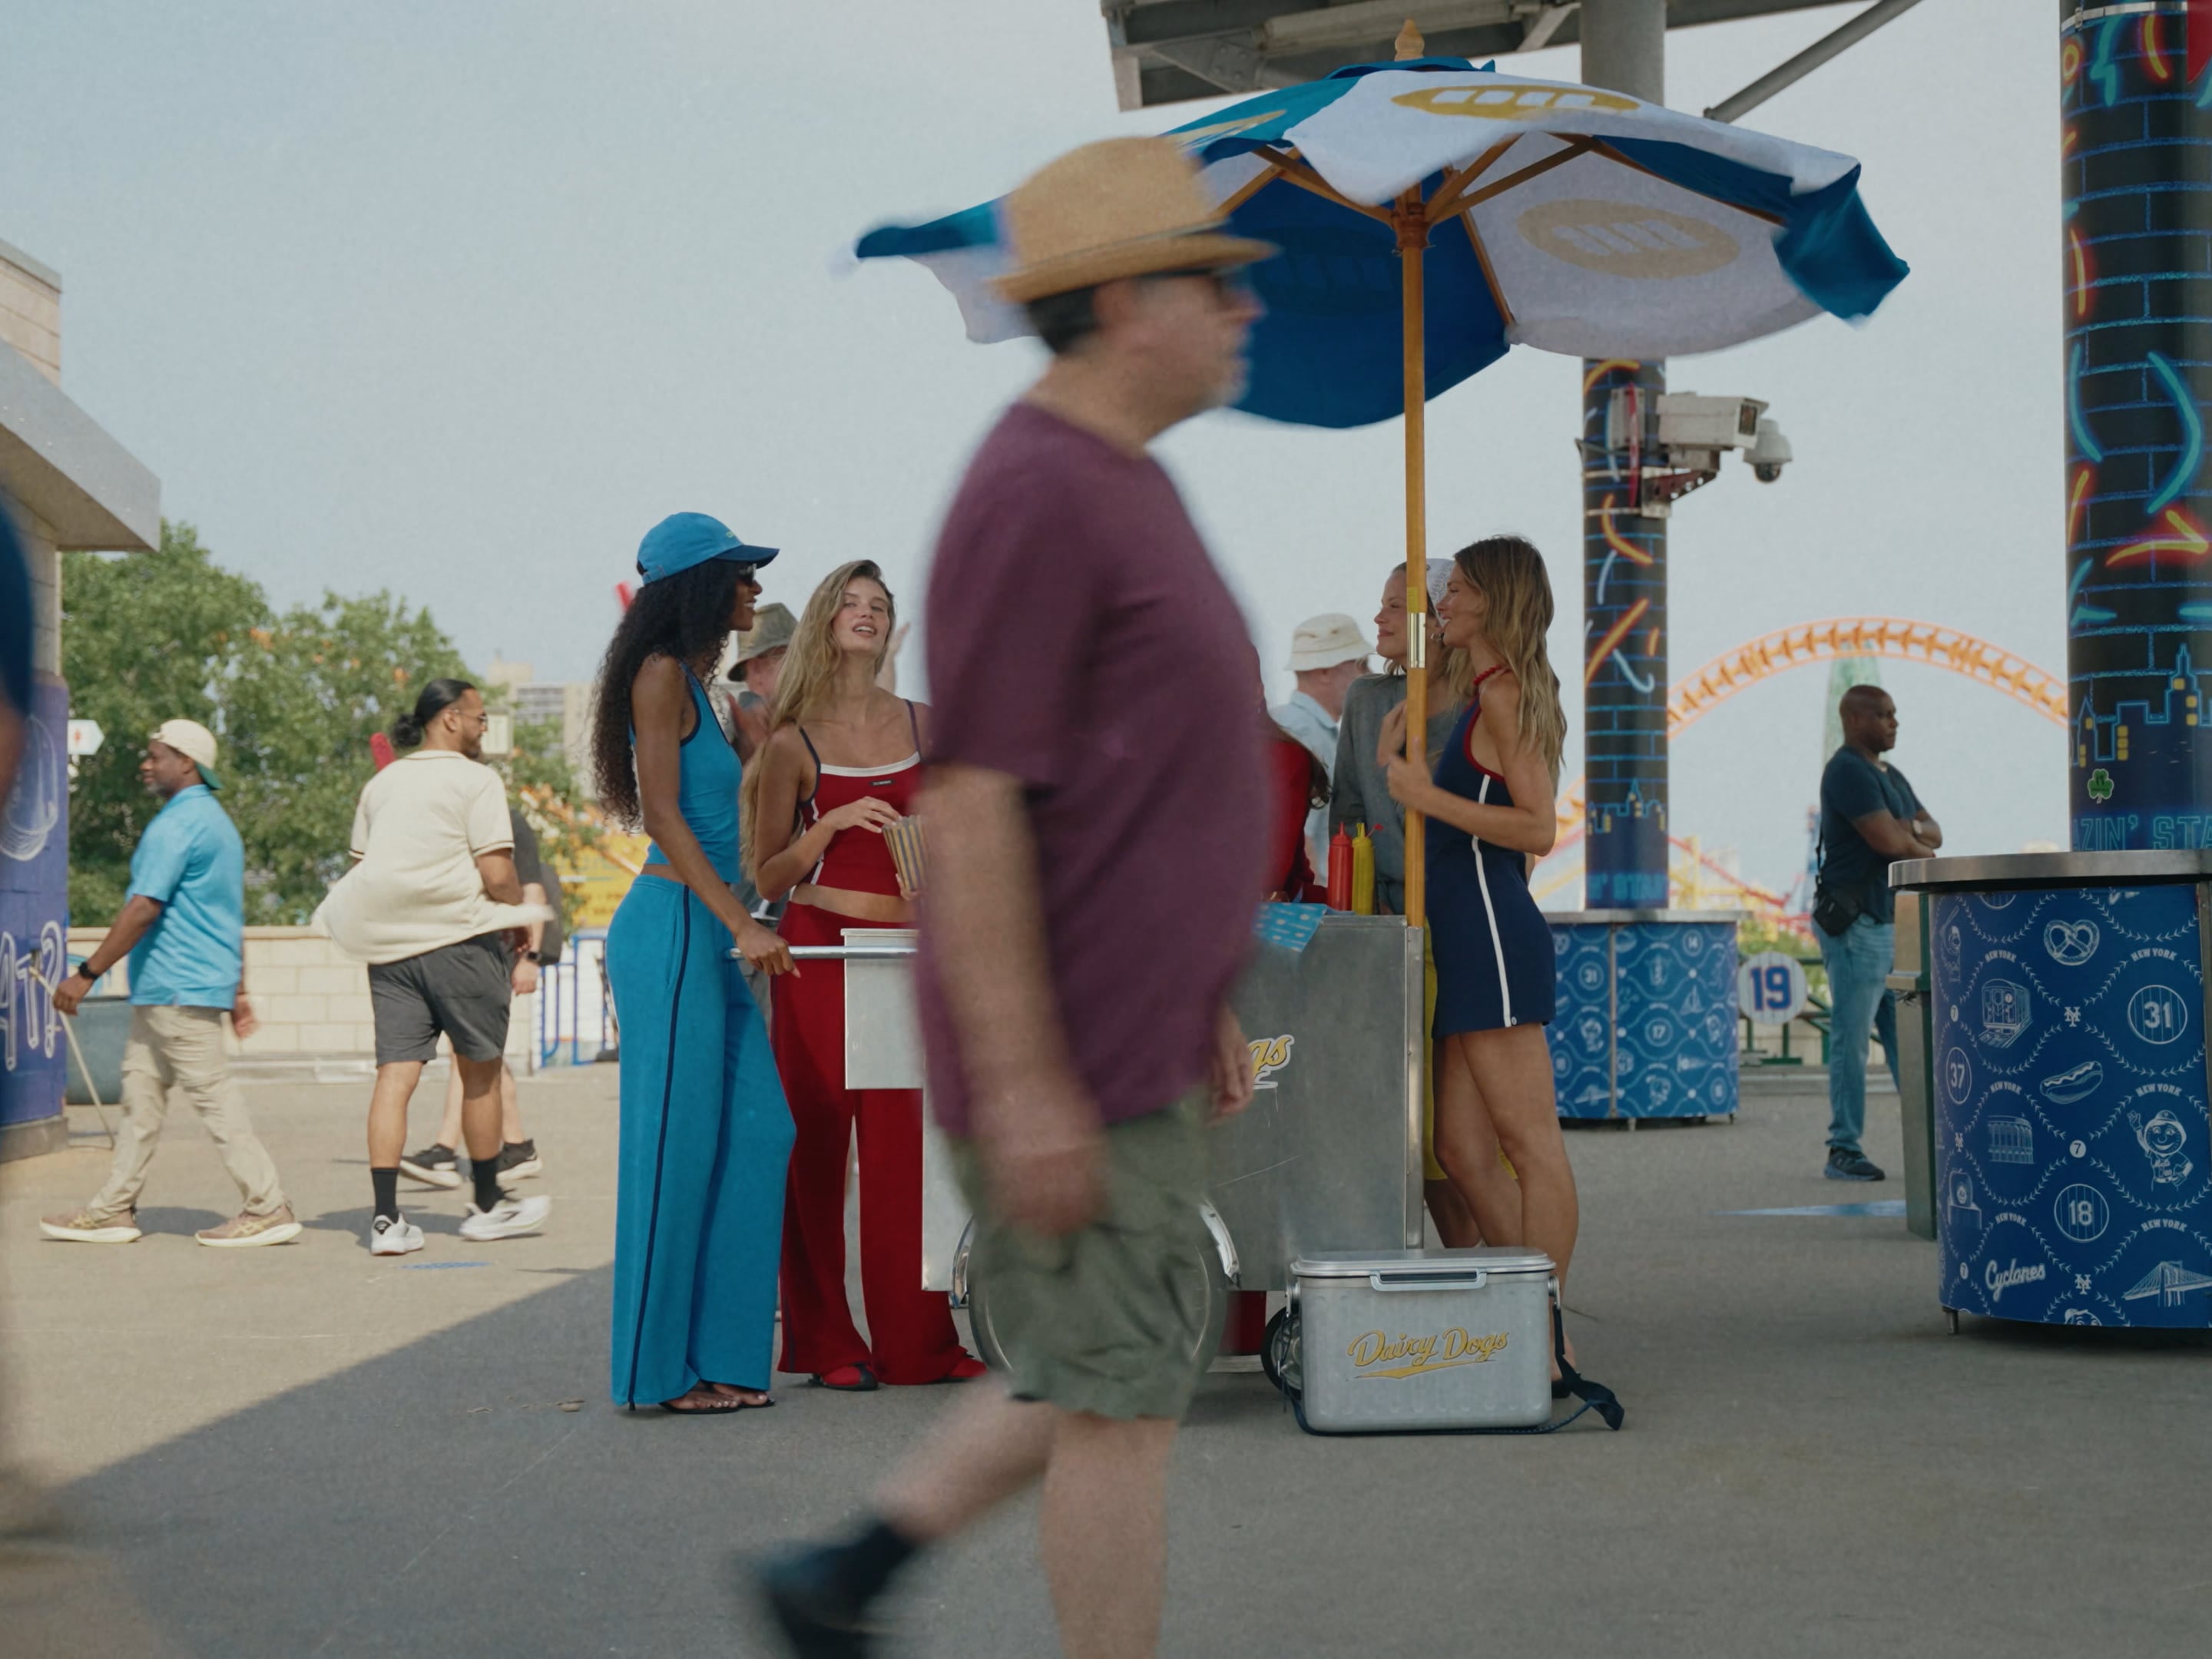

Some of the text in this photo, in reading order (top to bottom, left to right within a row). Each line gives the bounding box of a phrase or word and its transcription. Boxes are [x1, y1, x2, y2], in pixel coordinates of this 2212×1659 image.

[2131, 948, 2177, 962] NEW YORK
[1748, 965, 1793, 1012] 19
[2144, 1001, 2171, 1029] 31
[1950, 1062, 1965, 1088] 37
[2135, 1083, 2182, 1097] NEW YORK
[2068, 1200, 2093, 1227] 18
[2141, 1219, 2187, 1232] NEW YORK
[1985, 1257, 2046, 1303] Cyclones
[1347, 1326, 1509, 1366] Dairy Dogs
